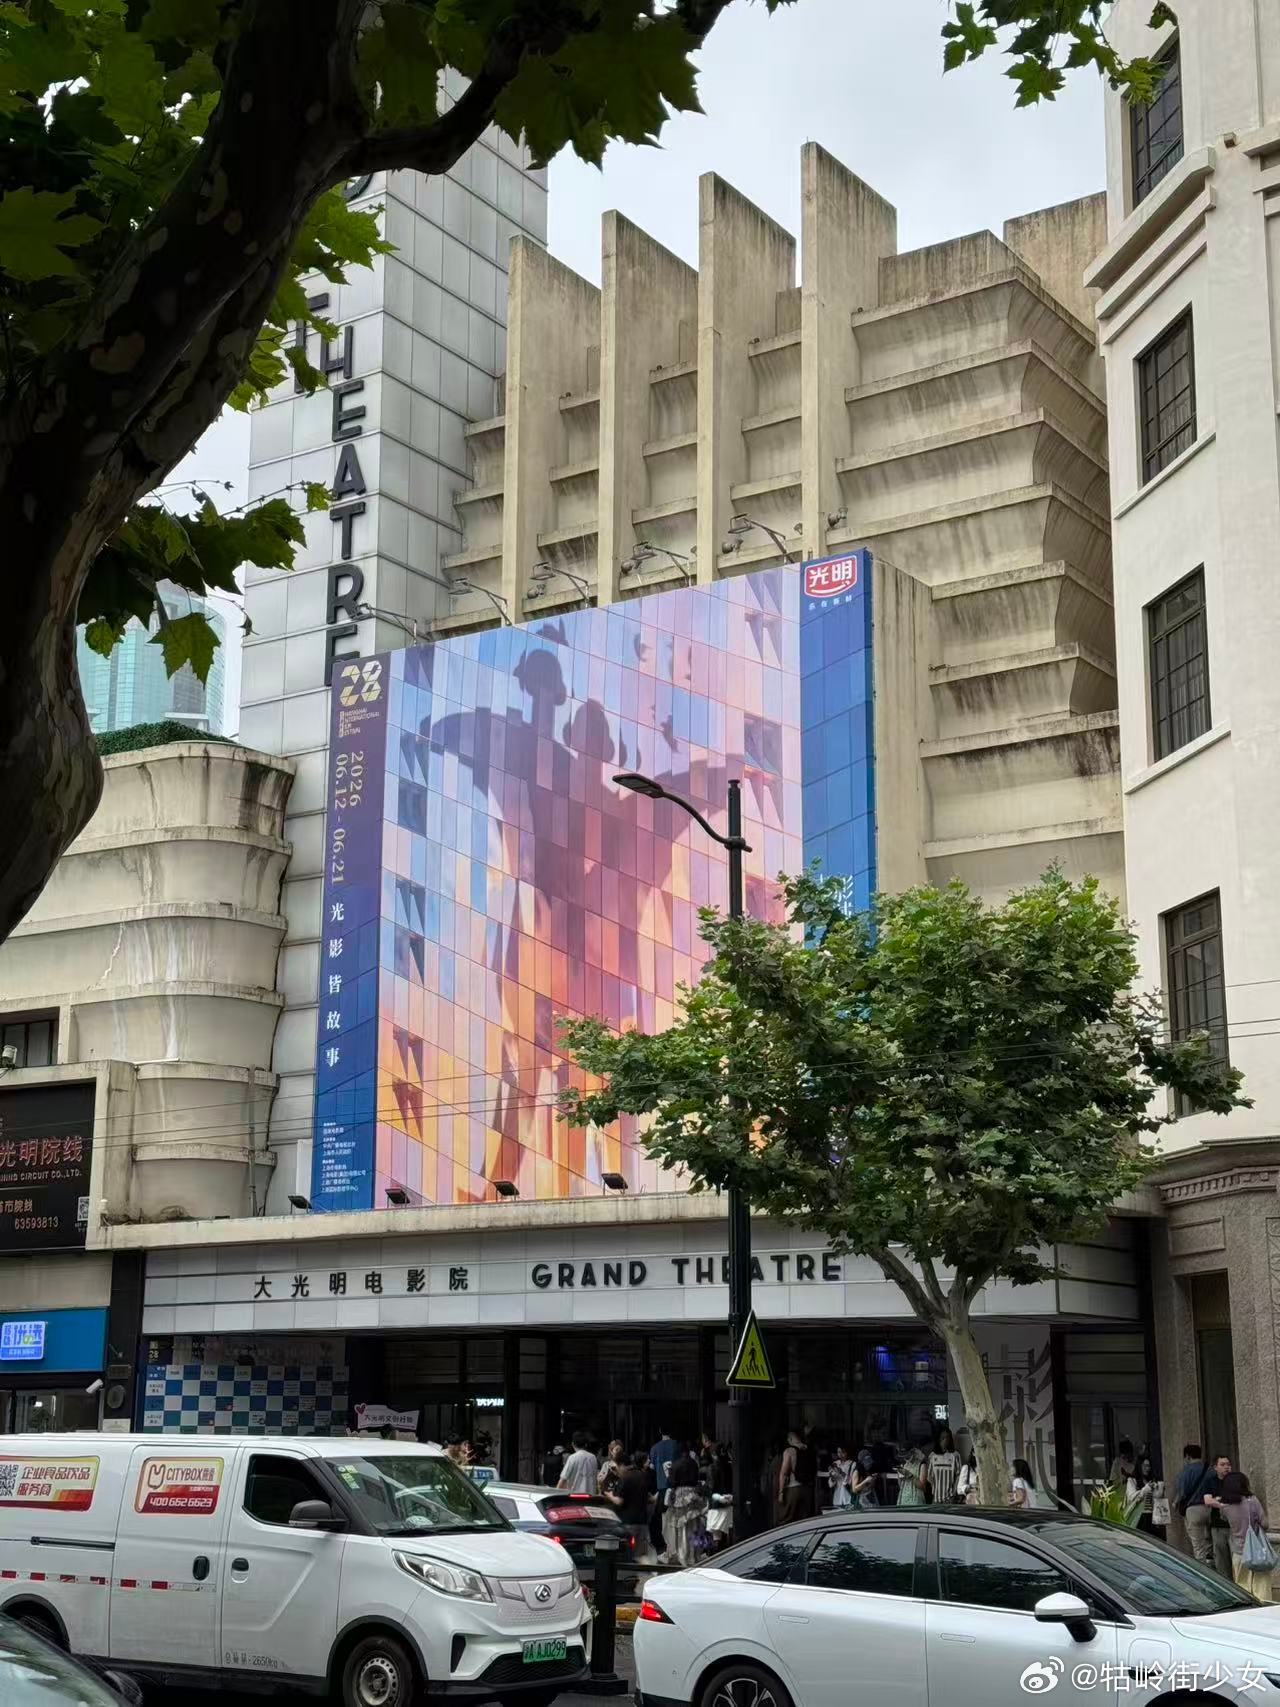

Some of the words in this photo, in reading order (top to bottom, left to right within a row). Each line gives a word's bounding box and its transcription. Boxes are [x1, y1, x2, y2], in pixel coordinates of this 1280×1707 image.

[808, 560, 853, 588] 光明
[334, 753, 349, 810] 06.12
[349, 750, 365, 808] 2026
[331, 828, 346, 885] 06.21
[325, 902, 345, 1068] 光影皆故事
[20, 1171, 49, 1182] CIRCUIT
[253, 1267, 468, 1298] 大光明电影院
[531, 1260, 647, 1289] GRAND
[21, 1465, 91, 1480] 企业食品饮品
[16, 1482, 52, 1497] 服务商
[149, 1496, 168, 1507] 400
